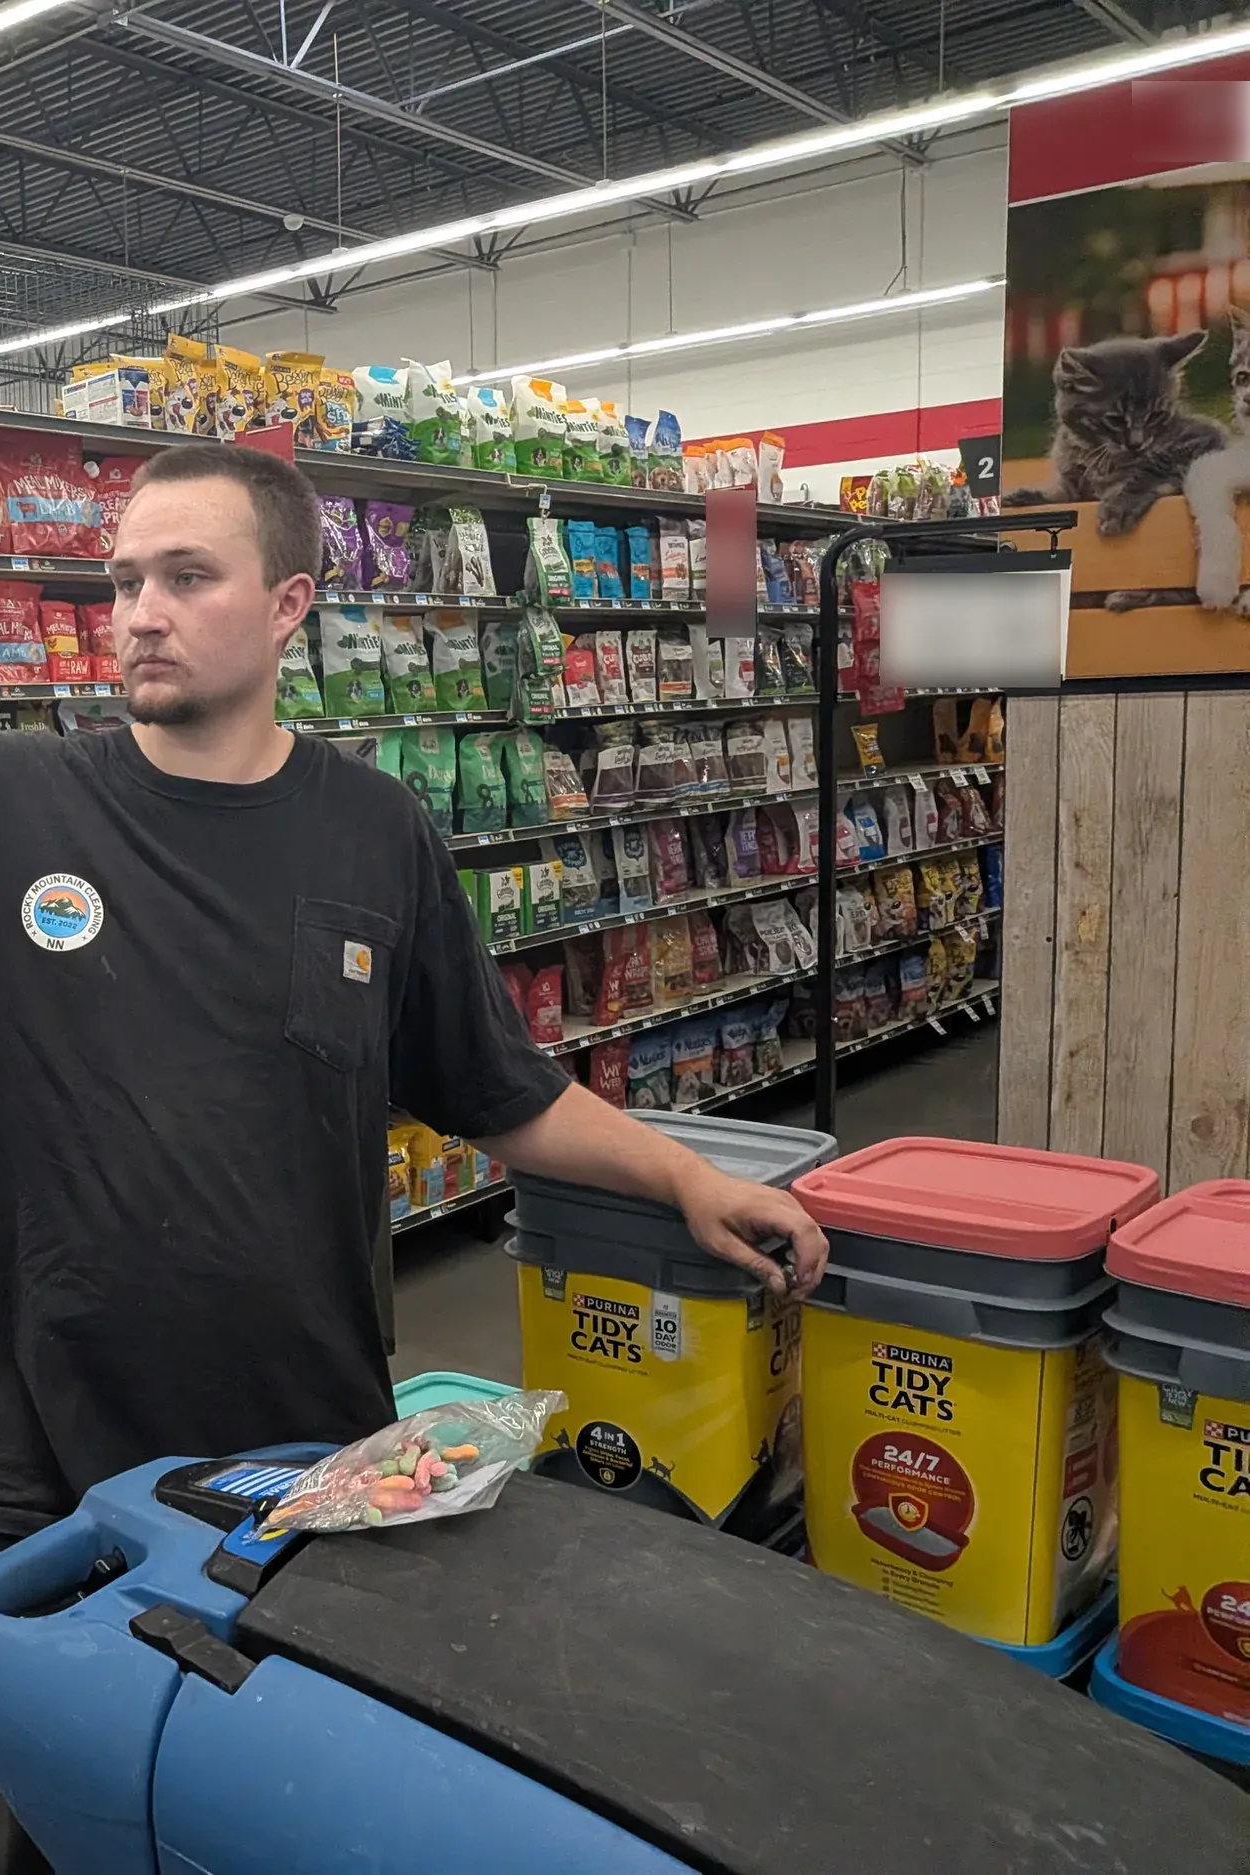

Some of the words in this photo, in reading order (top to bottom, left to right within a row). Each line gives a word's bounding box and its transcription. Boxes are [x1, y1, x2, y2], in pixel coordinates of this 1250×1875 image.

[273, 370, 314, 395] Beggin
[977, 456, 995, 480] 2
[13, 475, 46, 495] MEAL
[70, 658, 88, 675] RAW
[23, 893, 34, 930] ROCKY
[31, 875, 86, 895] MOUNTAIN
[84, 887, 102, 935] CLEANING
[41, 917, 57, 926] EST.
[58, 919, 78, 930] 2022
[46, 938, 65, 950] NN
[587, 1297, 637, 1318] PURINA
[573, 1310, 639, 1341] TIDY
[655, 1318, 677, 1334] 10
[571, 1330, 642, 1363] CATS
[655, 1332, 676, 1343] DAY
[655, 1340, 676, 1349] ODOR
[890, 1347, 950, 1370] PURINA
[871, 1360, 951, 1396] TIDY
[869, 1384, 954, 1421] CATS
[865, 1409, 901, 1422] MULTI-CAT
[590, 1426, 602, 1440] 4
[604, 1431, 615, 1441] IN
[616, 1433, 626, 1447] 1
[590, 1439, 627, 1455] STRENGTH
[884, 1444, 940, 1472] 24/7
[1204, 1440, 1250, 1472] TI
[871, 1458, 950, 1485] PERFORMANCE
